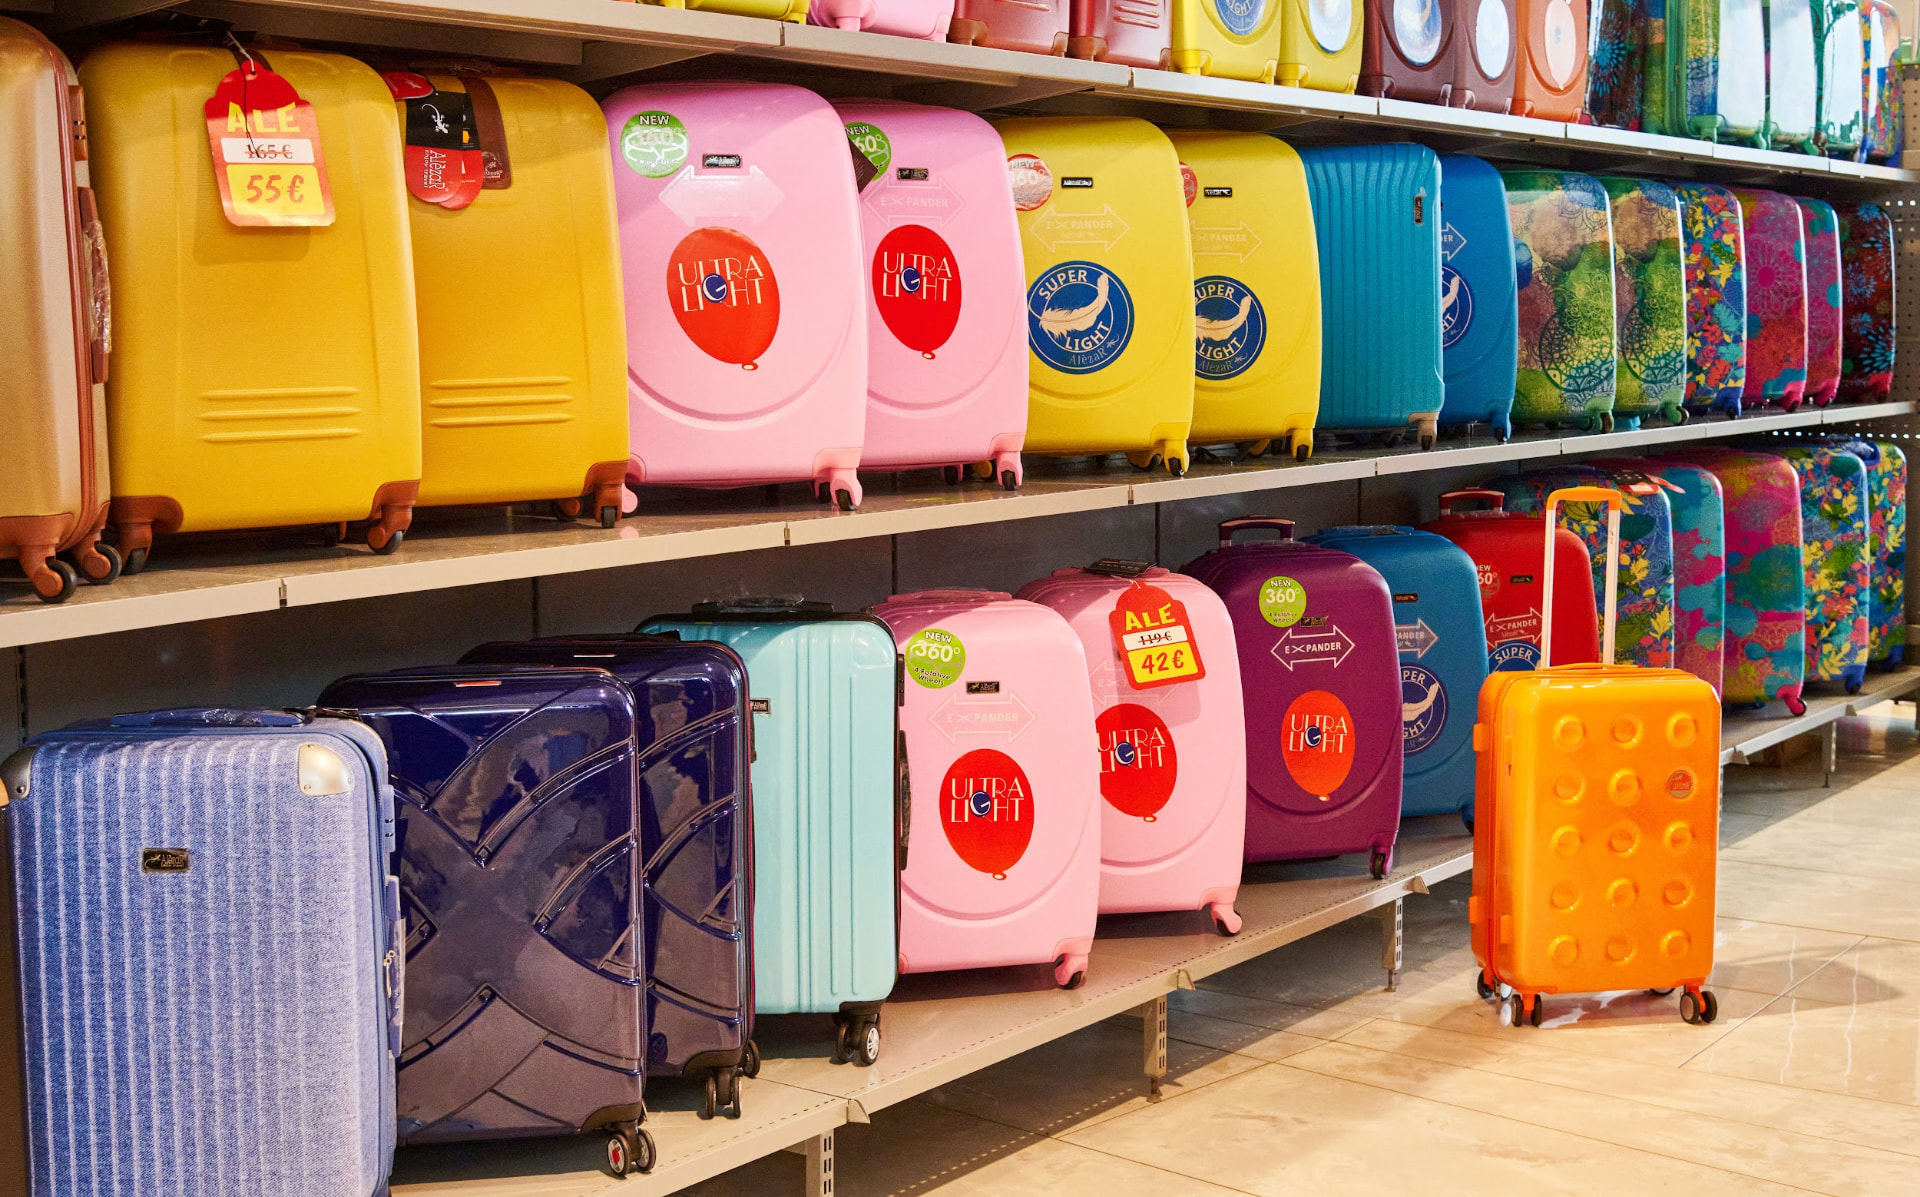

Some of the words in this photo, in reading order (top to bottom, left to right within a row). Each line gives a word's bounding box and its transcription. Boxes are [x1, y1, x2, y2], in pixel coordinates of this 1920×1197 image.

[1227, 0, 1251, 14] IGHT
[227, 101, 300, 132] ALE
[639, 115, 670, 125] NEW
[846, 125, 870, 136] NEW
[854, 134, 882, 152] 60°
[678, 254, 764, 286] ULTRA
[882, 251, 952, 278] ULTRA
[681, 274, 765, 312] LIGHT
[882, 267, 952, 302] LIGHT
[1038, 269, 1088, 300] SUPER
[1195, 284, 1235, 302] UPER
[1065, 320, 1110, 351] LIGHT
[1199, 336, 1241, 359] LIGHT
[1270, 579, 1291, 588] NEW
[1477, 572, 1498, 585] 60°
[1265, 587, 1301, 604] 360°
[1125, 602, 1176, 631] ALE
[1489, 618, 1538, 633] EXPANDER
[925, 631, 953, 644] NEW
[1396, 631, 1425, 640] ANDER
[914, 639, 961, 663] 360°
[1284, 641, 1342, 654] EXPANDER
[1495, 647, 1533, 664] SUPER
[1402, 670, 1426, 685] PER
[946, 712, 1018, 723] EXPANDER
[1291, 713, 1348, 734] ULTRA
[1403, 719, 1426, 738] GHT
[1097, 726, 1165, 752] ULTRA
[1289, 725, 1348, 754] LIGHT
[1098, 741, 1166, 774] LIGHT
[951, 777, 1024, 800] ULTRA
[951, 790, 1025, 823] LIGHT
